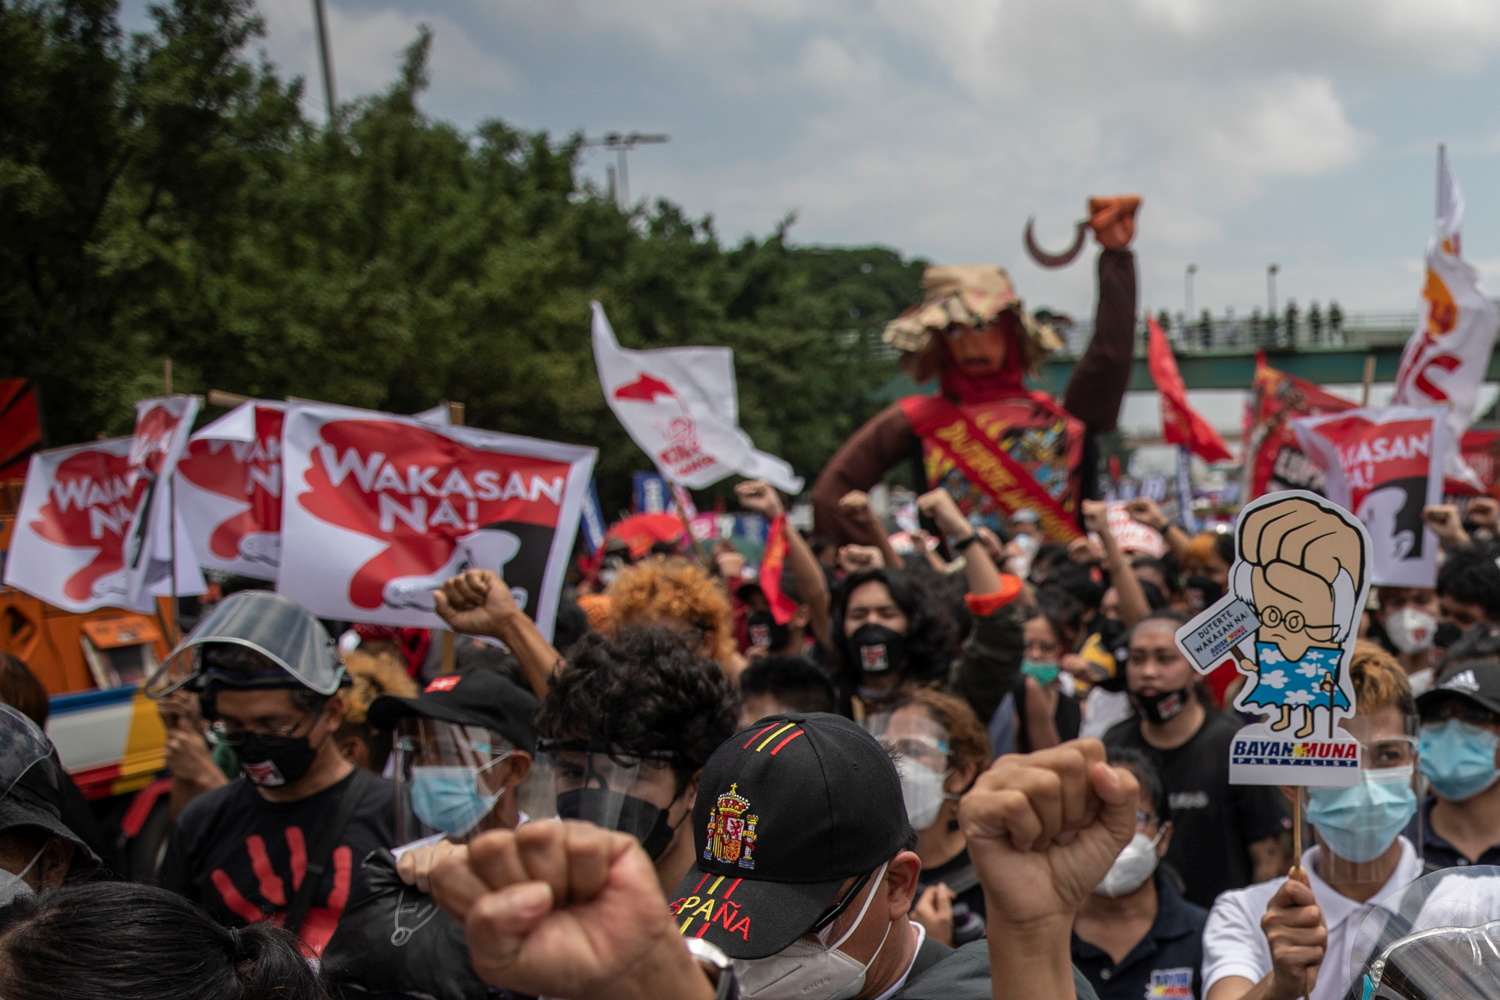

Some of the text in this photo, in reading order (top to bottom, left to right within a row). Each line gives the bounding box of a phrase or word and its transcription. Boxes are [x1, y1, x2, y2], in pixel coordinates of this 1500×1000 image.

[317, 443, 565, 506] WAKASAN
[378, 493, 479, 533] NA!
[1194, 622, 1235, 653] WAKASAN
[1198, 609, 1233, 639] DUTERTE
[1232, 741, 1357, 758] BAYAN MUNA
[667, 896, 751, 942] SPAÑA
